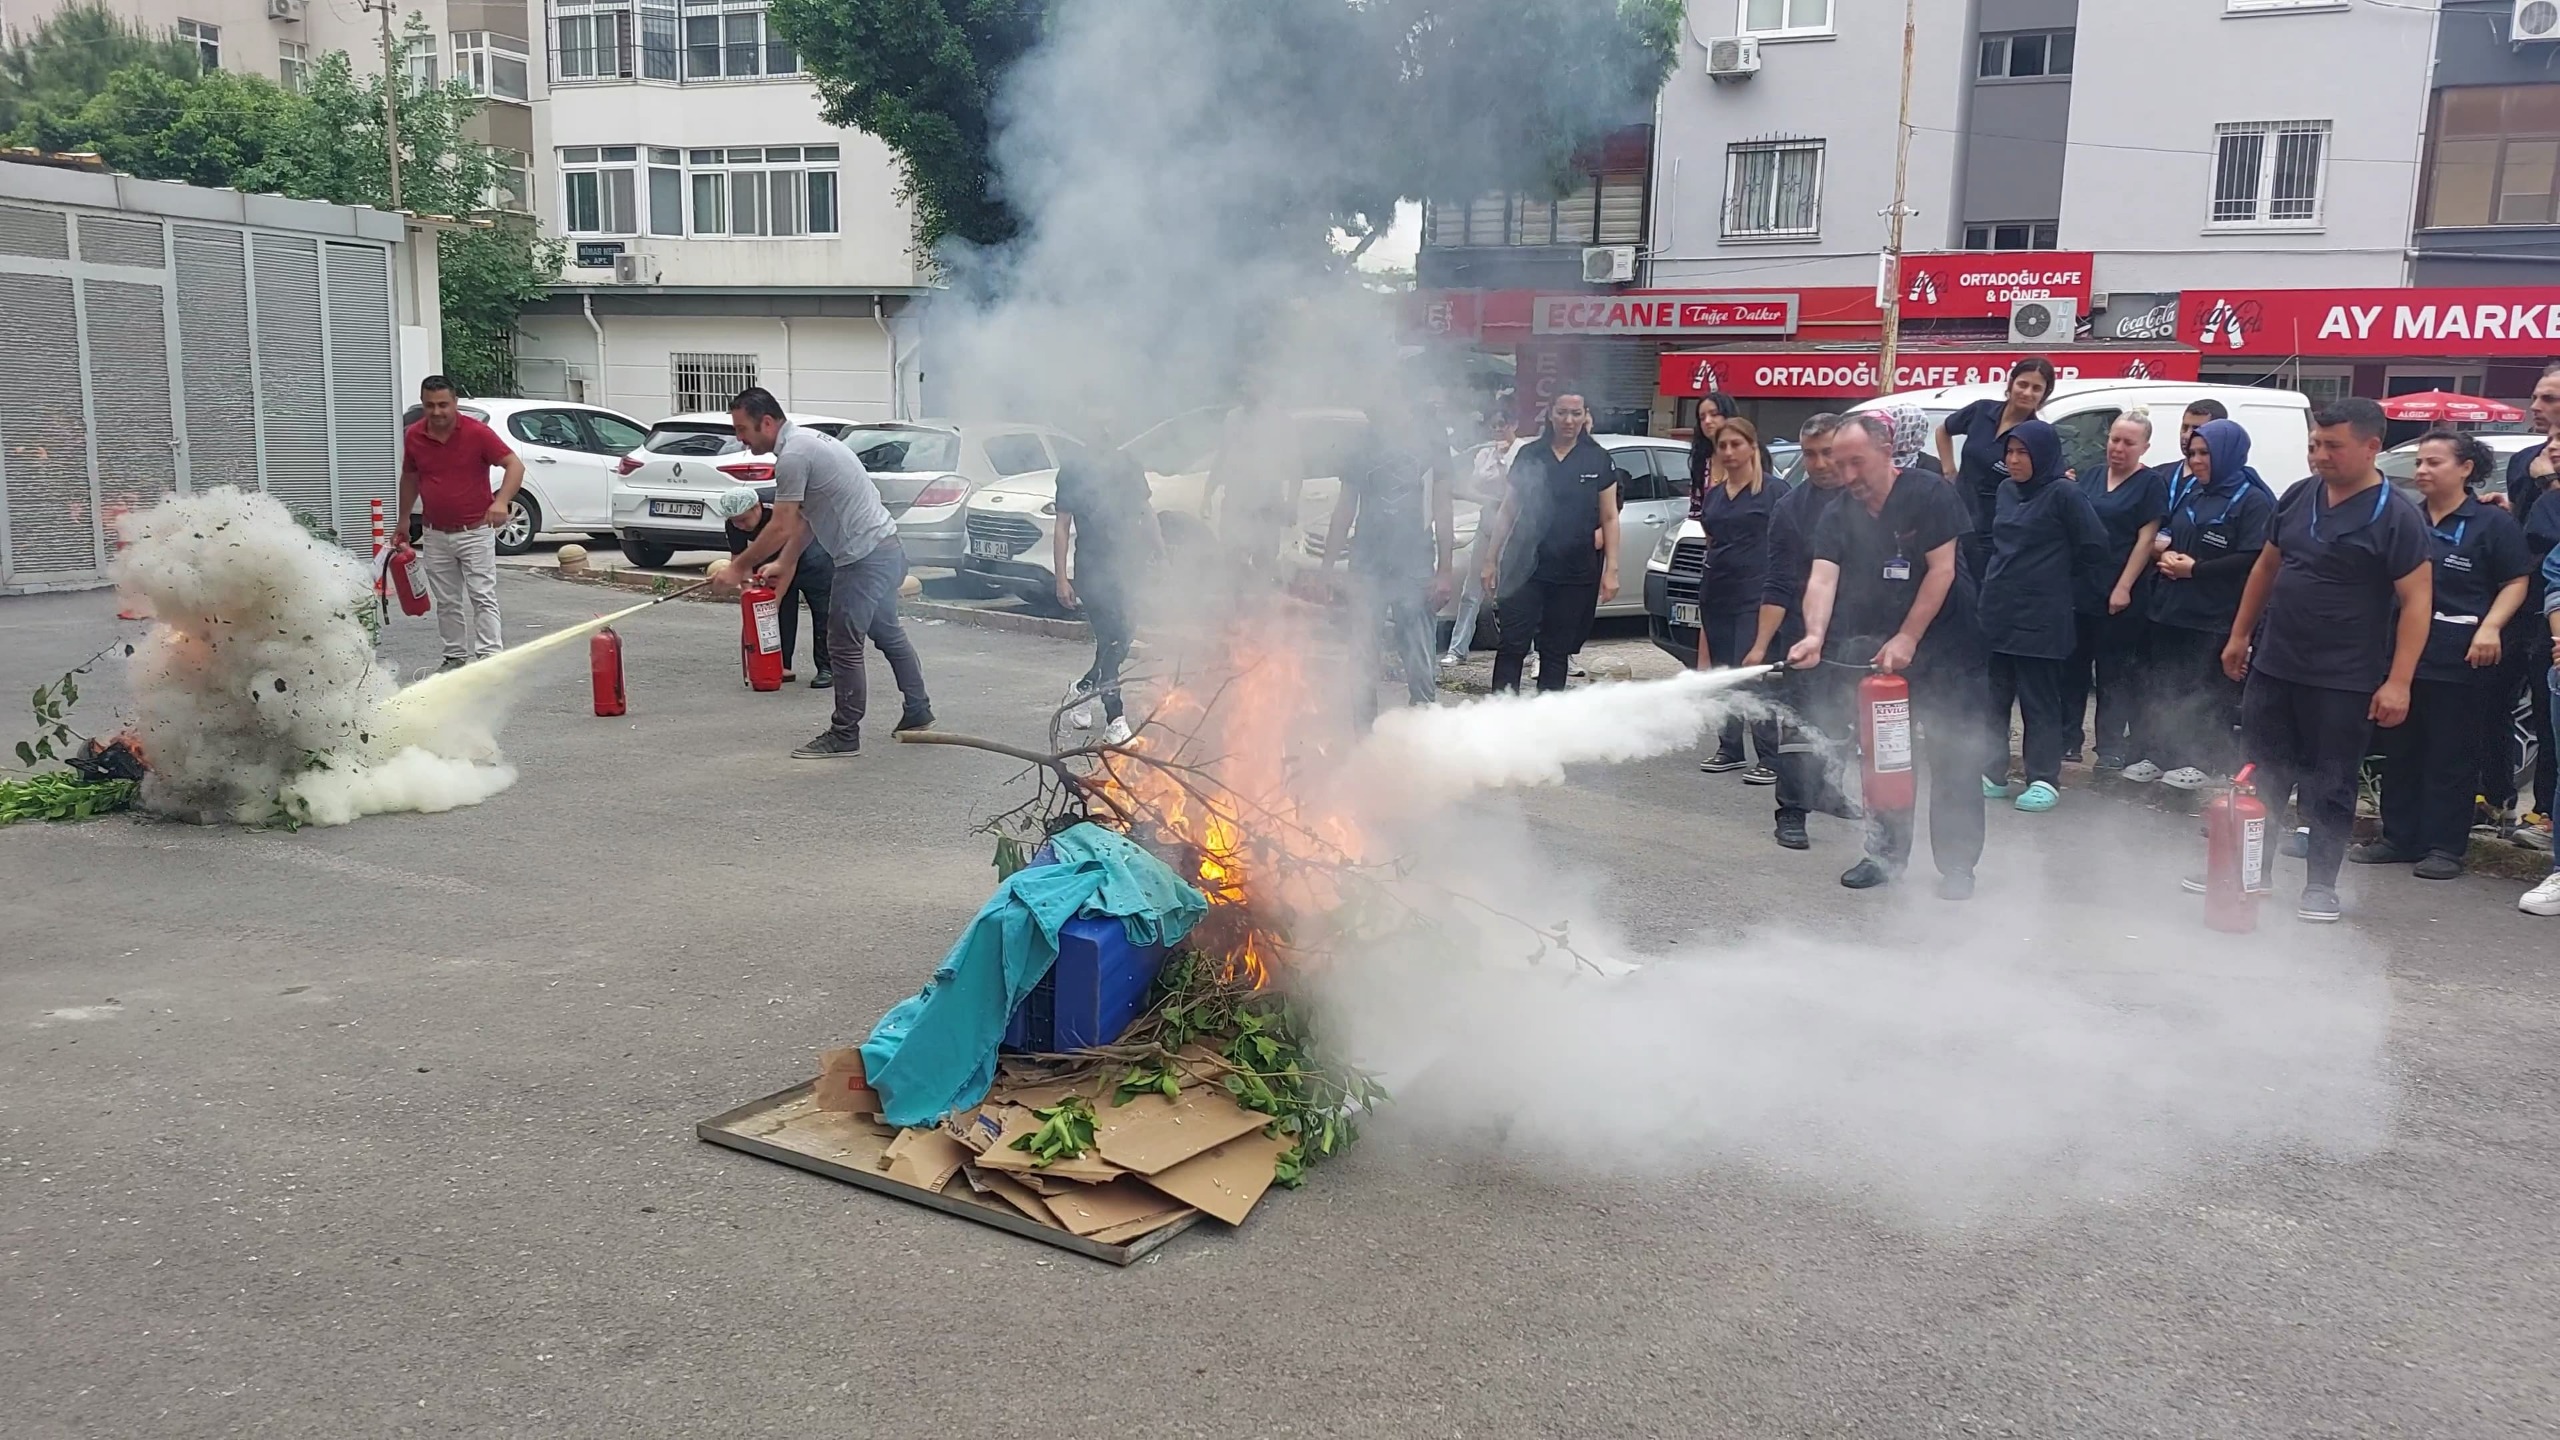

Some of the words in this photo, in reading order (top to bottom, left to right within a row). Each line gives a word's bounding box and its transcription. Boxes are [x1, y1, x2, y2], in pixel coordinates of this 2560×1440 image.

[1959, 269, 2040, 287] ORTADOĞU
[2043, 271, 2082, 285] CAFE
[1986, 290, 1996, 302] &
[1548, 302, 1676, 328] ECZANE
[1685, 305, 1729, 325] Tuğçe
[1732, 306, 1782, 321] Dalkır
[2316, 305, 2384, 340] AY
[2127, 324, 2173, 338] ero
[1894, 365, 1959, 386] CAFE
[1964, 366, 1982, 384] &
[2397, 411, 2434, 419] ALGIDA
[655, 502, 665, 513] 01
[668, 503, 683, 513] AJT
[687, 504, 702, 515] 799
[1676, 605, 1686, 620] 01
